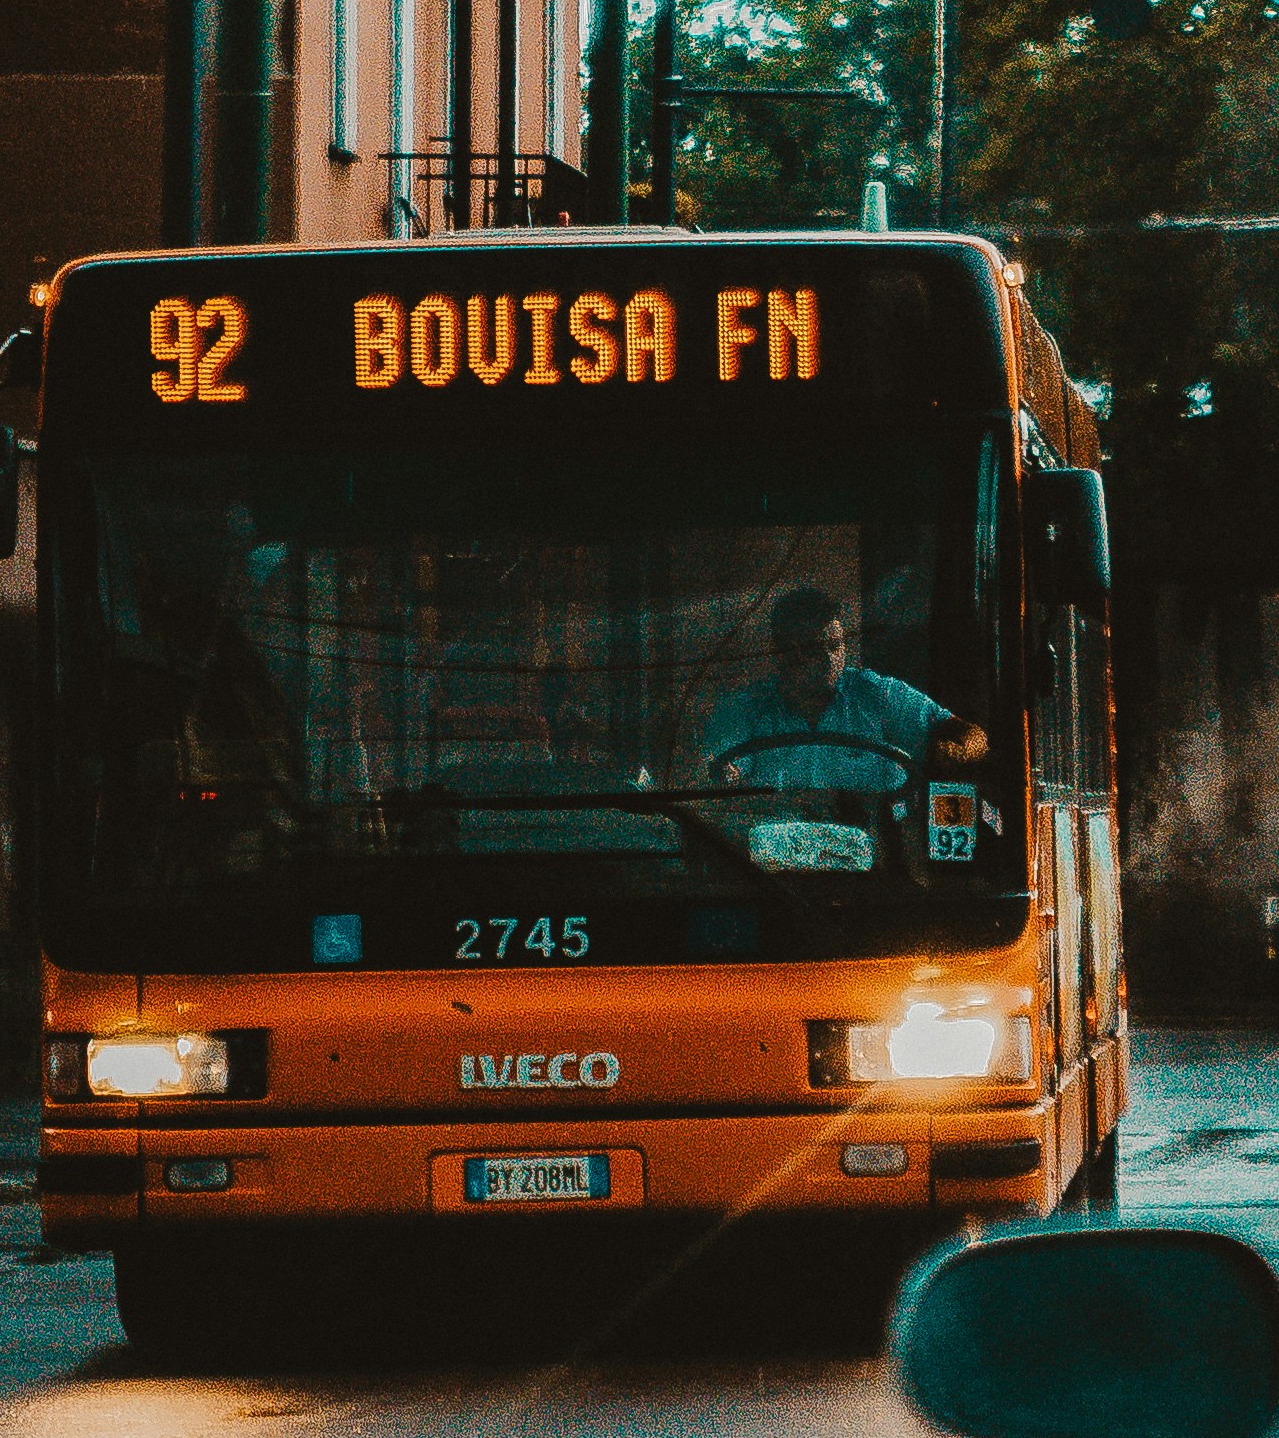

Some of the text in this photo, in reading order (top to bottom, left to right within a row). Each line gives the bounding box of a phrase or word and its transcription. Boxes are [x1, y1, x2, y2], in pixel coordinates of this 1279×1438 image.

[149, 286, 822, 403] 92 BOVISA FN
[937, 829, 969, 857] 92
[455, 915, 590, 960] 2745
[459, 1051, 620, 1090] IVECO
